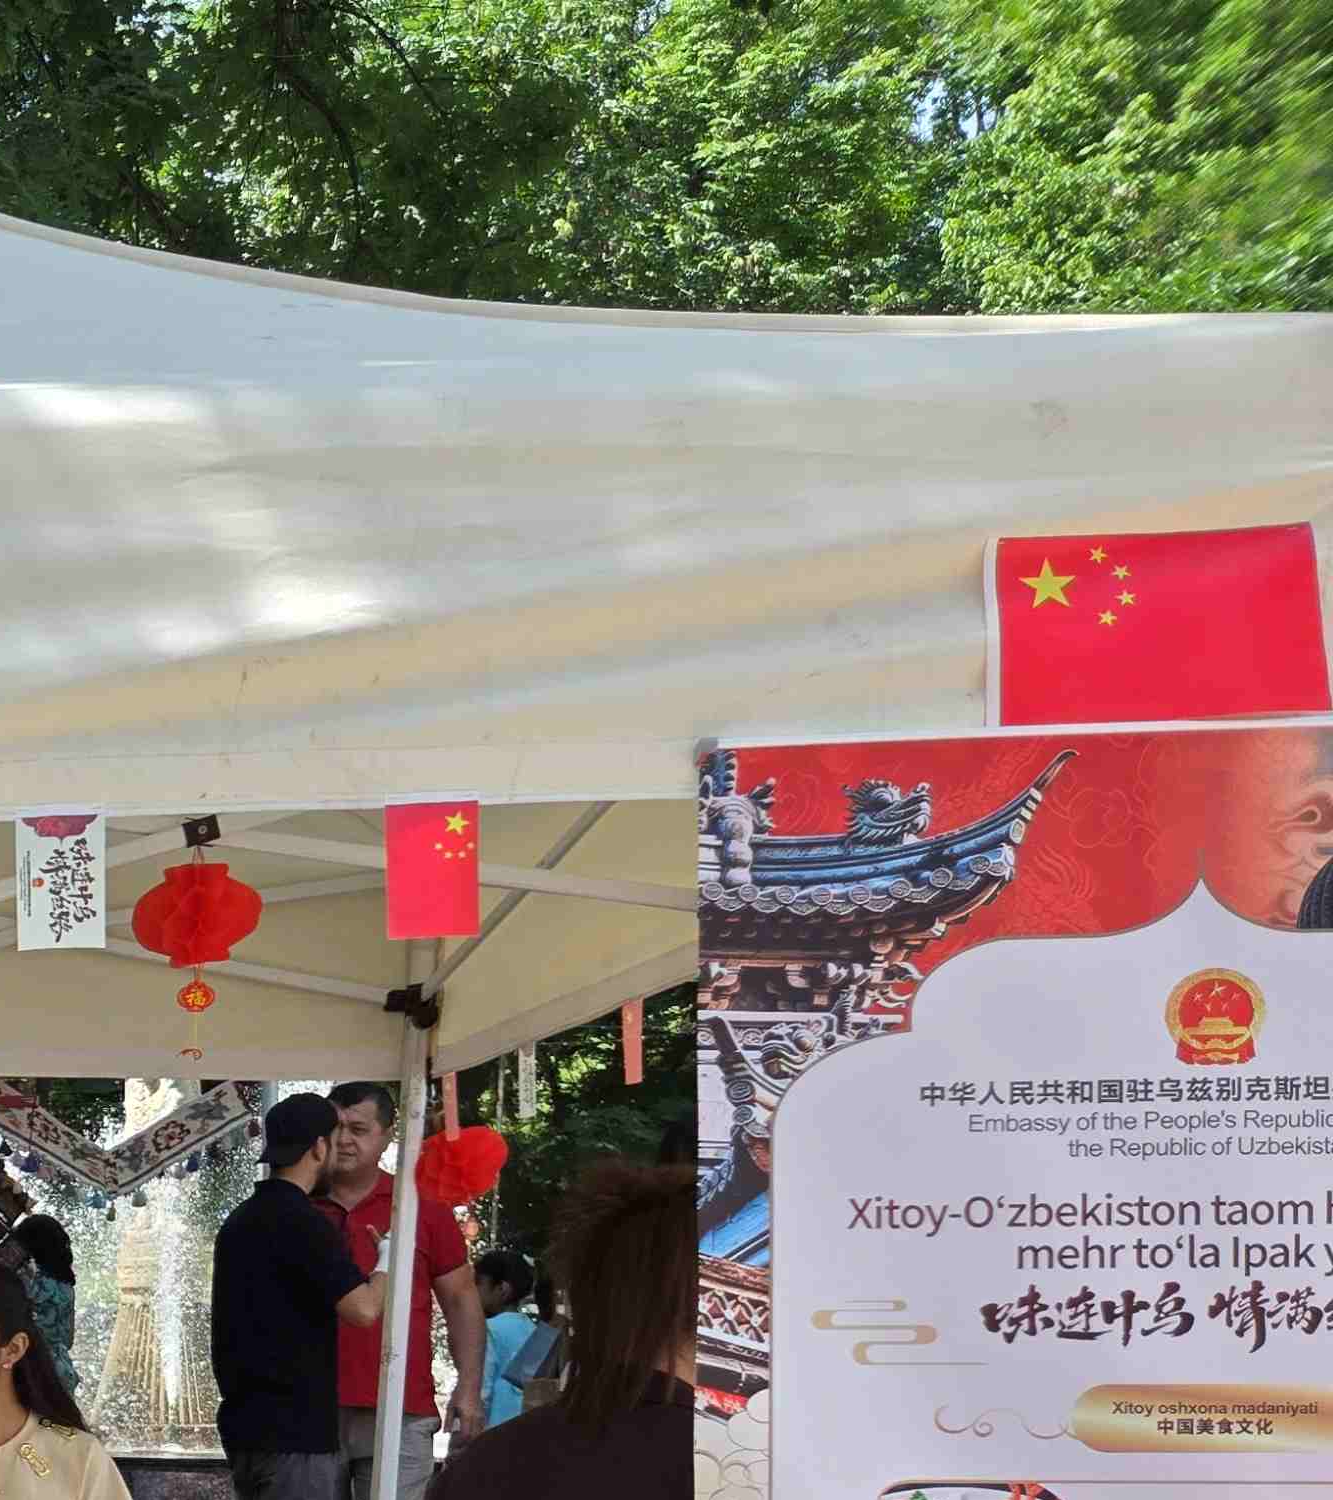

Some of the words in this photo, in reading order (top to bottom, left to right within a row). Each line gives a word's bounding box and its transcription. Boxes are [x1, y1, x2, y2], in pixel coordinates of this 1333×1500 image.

[920, 1076, 1333, 1107] 中华人民共和国驻乌兹别克斯坦
[968, 1113, 1070, 1135] Embassy
[1076, 1111, 1098, 1131] of
[1103, 1111, 1137, 1130] the
[1144, 1110, 1237, 1132] People's
[1244, 1108, 1333, 1132] Republic
[1068, 1139, 1104, 1158] the
[1110, 1138, 1206, 1160] Republic
[1211, 1137, 1232, 1155] of
[1238, 1136, 1333, 1155] Uzbekist
[847, 1193, 1201, 1238] Xitoy-O‘zbekiston
[1211, 1195, 1314, 1226] taom
[1017, 1235, 1125, 1269] mehr
[1136, 1234, 1221, 1268] to‘la
[1233, 1234, 1315, 1277] Ipak
[981, 1281, 1195, 1347] 味连中乌
[1112, 1401, 1153, 1417] Xitoy
[1158, 1402, 1227, 1415] oshxona
[1231, 1401, 1318, 1417] madaniyati
[1157, 1418, 1274, 1435] 中国美食文化
